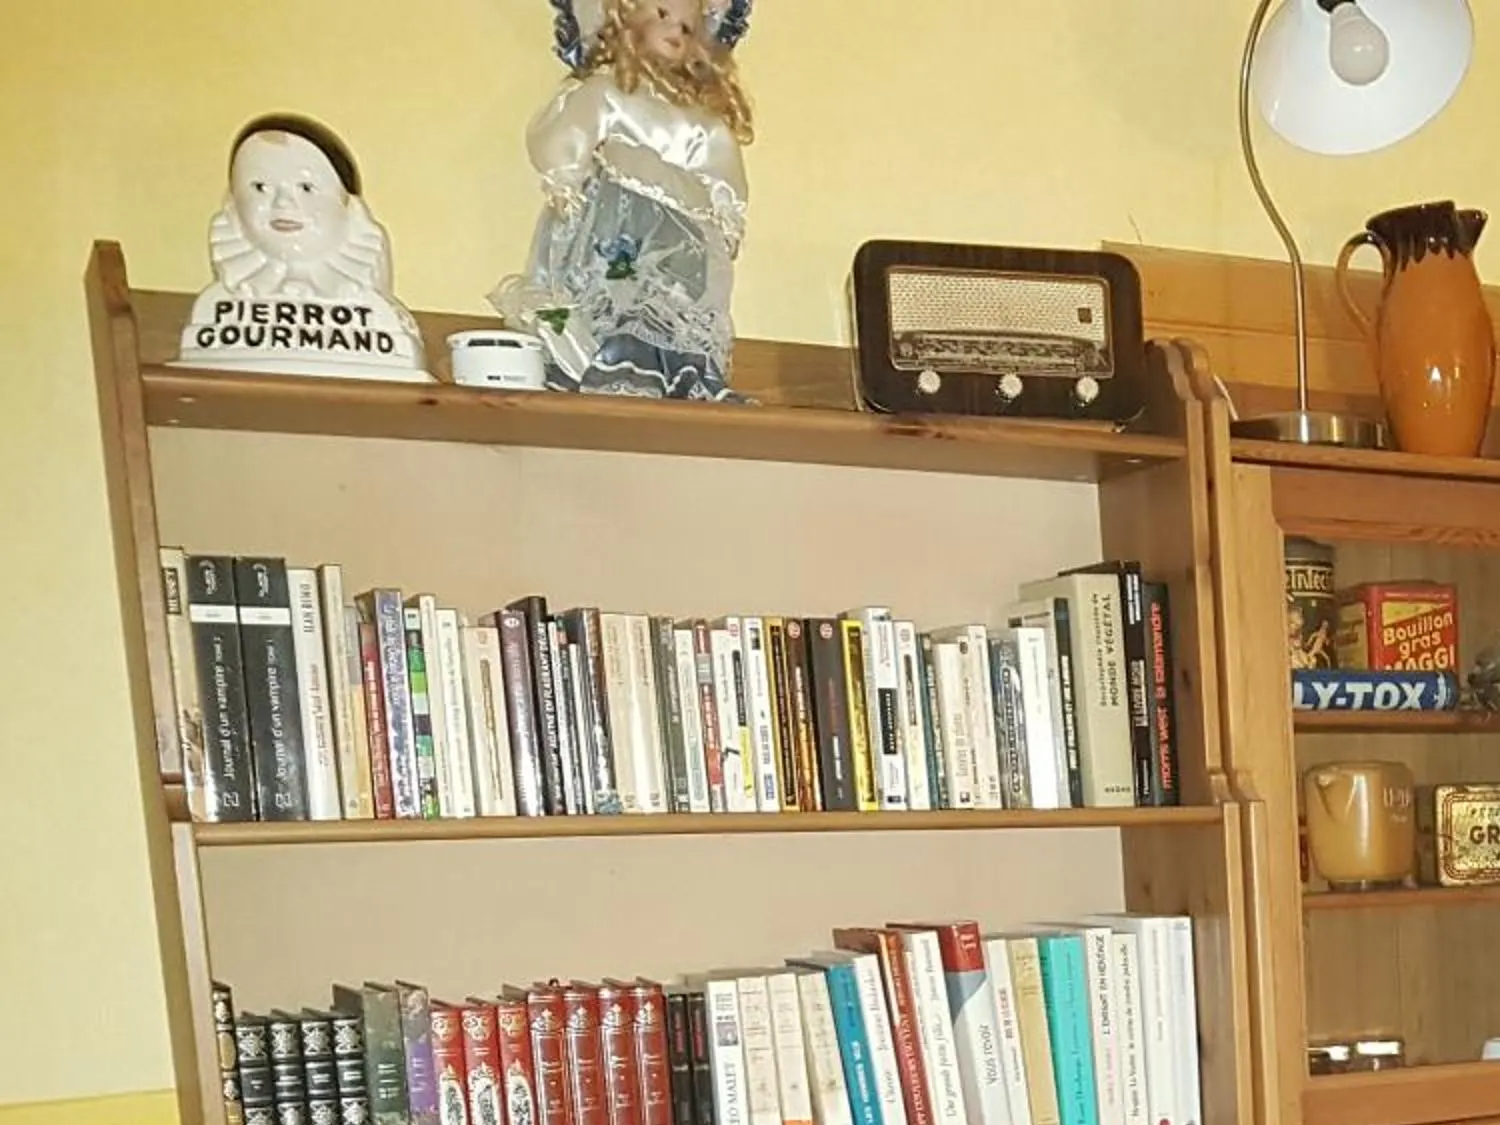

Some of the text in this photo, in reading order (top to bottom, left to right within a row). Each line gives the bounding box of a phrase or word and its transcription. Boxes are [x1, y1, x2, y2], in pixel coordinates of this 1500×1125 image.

[214, 300, 373, 325] PIERROT
[196, 326, 395, 355] GOURMAND
[1383, 611, 1453, 645] Bouillon
[1384, 646, 1455, 671] AGGI
[1400, 633, 1441, 659] gras
[213, 665, 229, 709] vampire
[267, 668, 281, 710] vampire
[1106, 660, 1119, 706] MONDE
[218, 712, 231, 737] d'un
[271, 714, 283, 737] d'un
[221, 740, 236, 780] Journal
[723, 1061, 738, 1105] MALET
